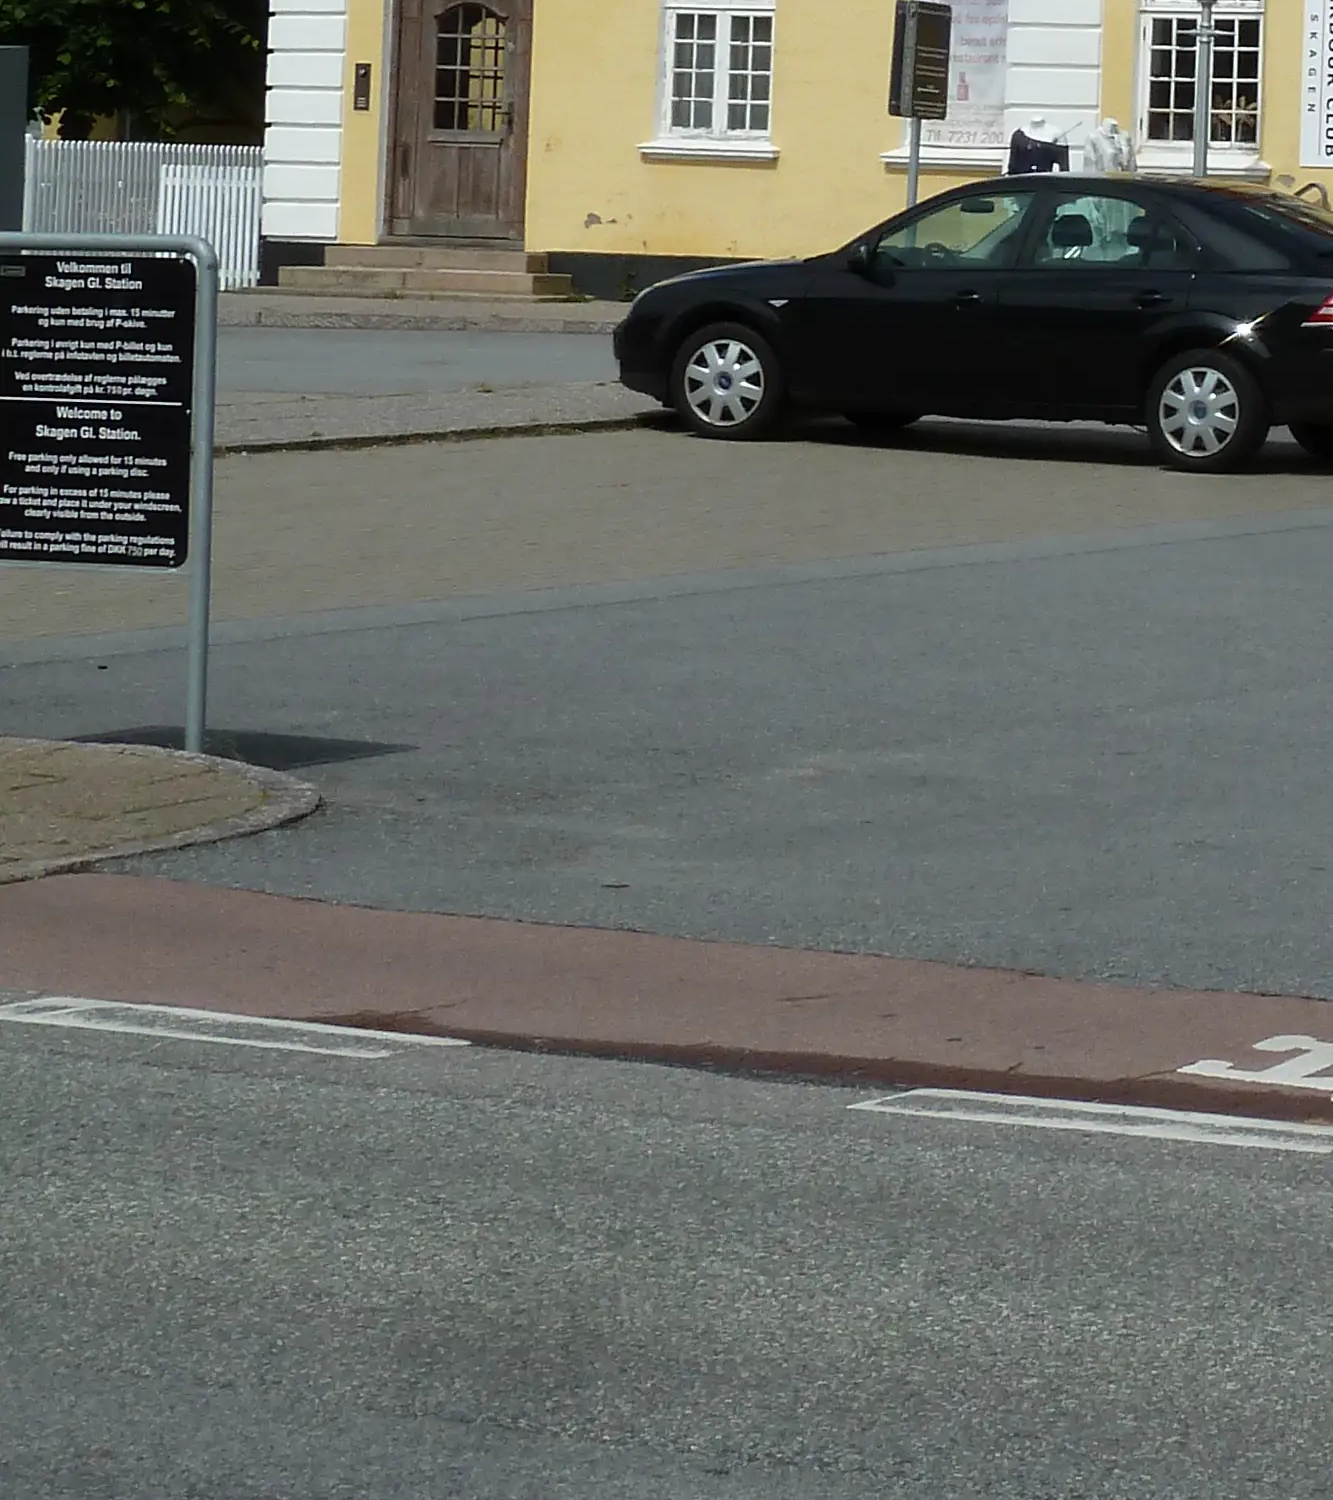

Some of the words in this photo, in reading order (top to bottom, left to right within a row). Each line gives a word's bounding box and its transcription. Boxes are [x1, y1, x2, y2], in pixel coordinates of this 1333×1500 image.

[1307, 14, 1319, 112] SKAGEN
[948, 131, 977, 143] 7231
[980, 132, 1004, 144] 200
[57, 262, 118, 274] Velkommen
[121, 263, 131, 274] til
[45, 276, 84, 290] Skagen
[105, 279, 142, 289] Station
[12, 305, 49, 316] Parkering
[72, 307, 102, 317] betaling
[141, 309, 175, 317] minutter
[38, 319, 48, 328] og
[86, 319, 104, 329] brug
[12, 338, 49, 349] Parkering
[145, 344, 155, 352] og
[157, 343, 172, 351] kun
[54, 350, 64, 360] på
[107, 353, 116, 362] og
[15, 372, 30, 380] Ved
[83, 385, 94, 395] på
[56, 406, 108, 420] Welcome
[110, 409, 122, 420] to
[36, 425, 77, 440] Skagen
[99, 428, 141, 440] Station.
[8, 452, 26, 461] Free
[28, 453, 57, 464] parking
[59, 455, 76, 464] only
[78, 455, 108, 464] allowed
[110, 456, 121, 464] for
[135, 457, 167, 466] minutes
[25, 464, 40, 472] and
[42, 465, 59, 474] only
[68, 467, 90, 476] using
[99, 467, 128, 478] parking
[130, 468, 149, 477] disc.
[4, 485, 17, 493] For
[18, 486, 48, 496] parking
[110, 490, 142, 498] minutes
[144, 491, 170, 500] please
[19, 497, 41, 506] ticket
[59, 500, 80, 508] place
[89, 501, 112, 509] under
[24, 509, 51, 519] clearly
[53, 510, 78, 519] visible
[100, 511, 113, 520] the
[115, 512, 146, 521] outside.
[0, 528, 23, 538] ailure
[34, 531, 63, 541] comply
[65, 532, 82, 541] with
[84, 533, 96, 541] the
[98, 534, 128, 544] parking
[130, 536, 174, 545] regulations
[9, 541, 32, 550] result
[50, 544, 79, 554] parking
[81, 544, 96, 553] fine
[108, 545, 126, 554] DKK
[144, 548, 157, 557] per
[159, 548, 176, 558] day.
